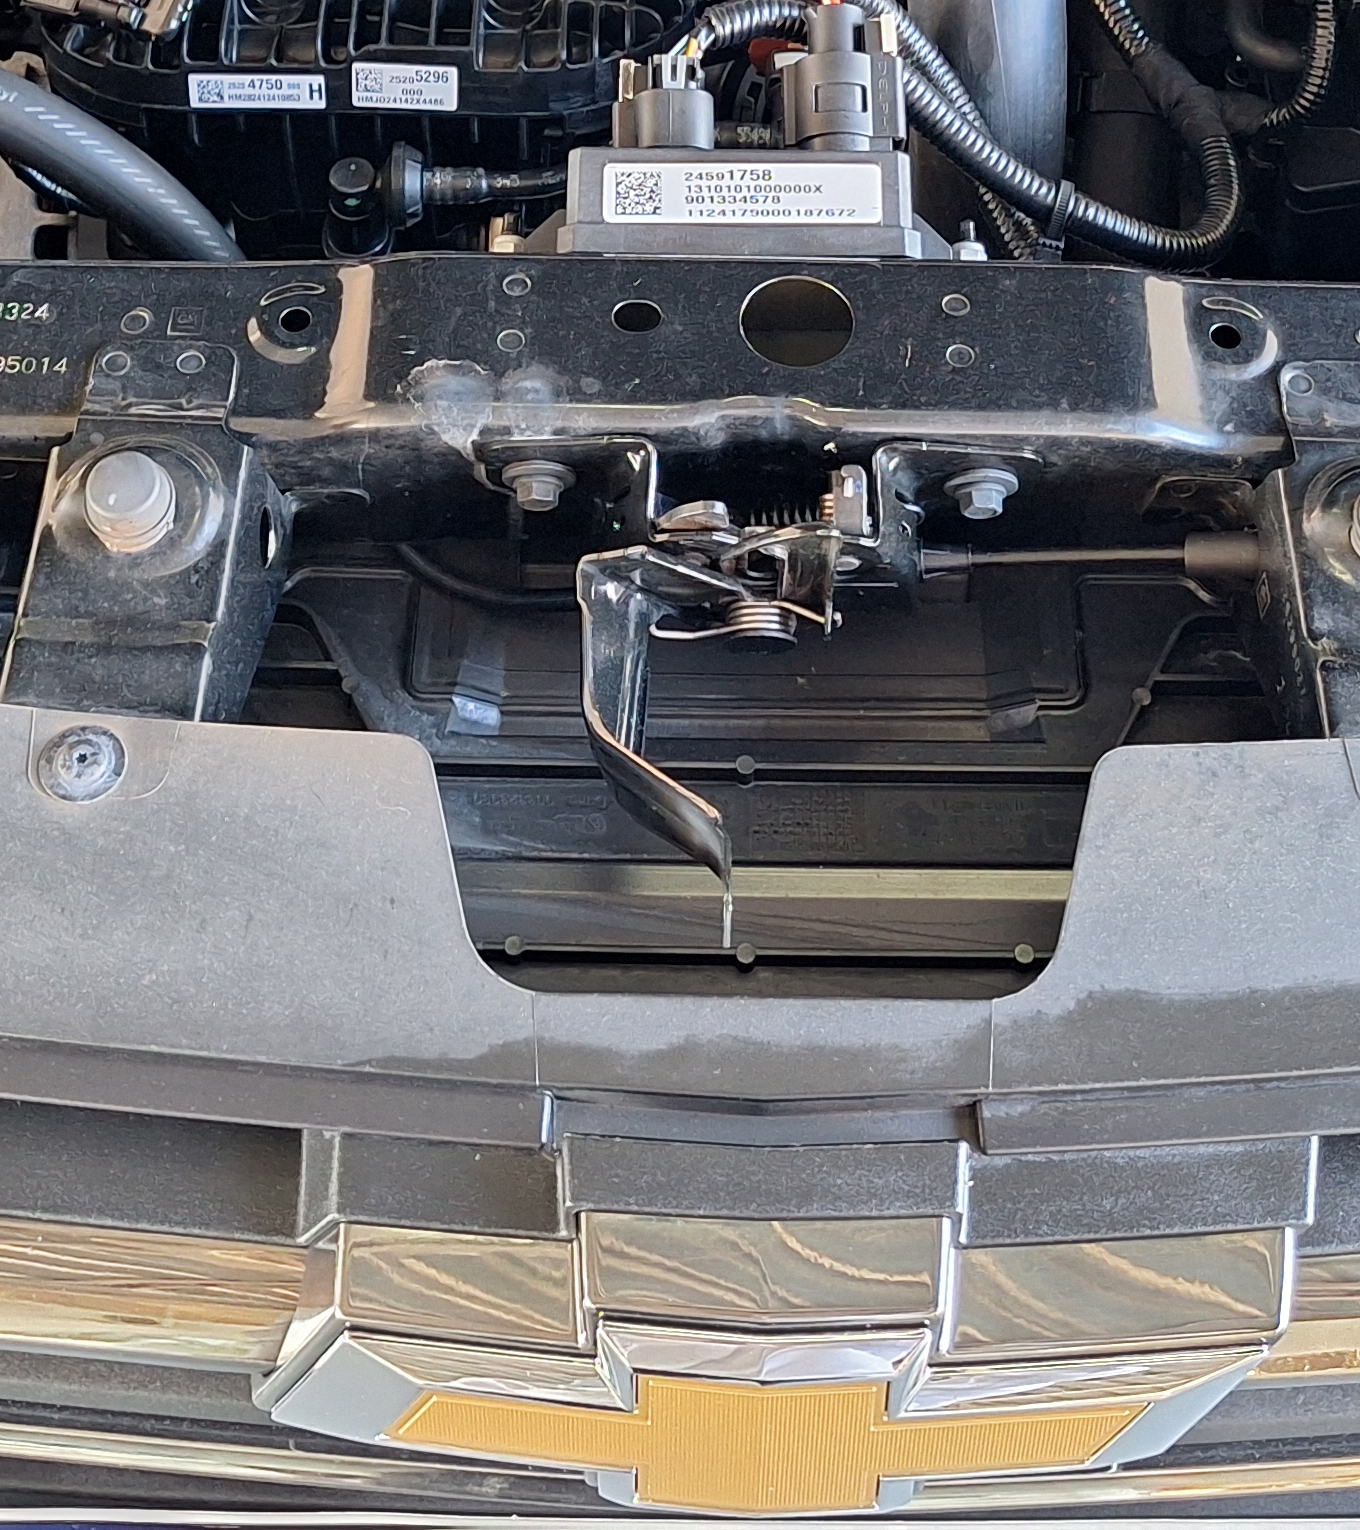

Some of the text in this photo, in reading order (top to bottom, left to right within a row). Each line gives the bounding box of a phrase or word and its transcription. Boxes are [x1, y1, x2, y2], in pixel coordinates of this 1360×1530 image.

[247, 78, 283, 91] 4750
[308, 83, 323, 101] H
[401, 88, 424, 97] 000
[684, 169, 772, 182] 24591758
[684, 184, 824, 195] 1310101000000X
[684, 195, 781, 205] 901334578
[686, 208, 857, 218] 1124179000187672
